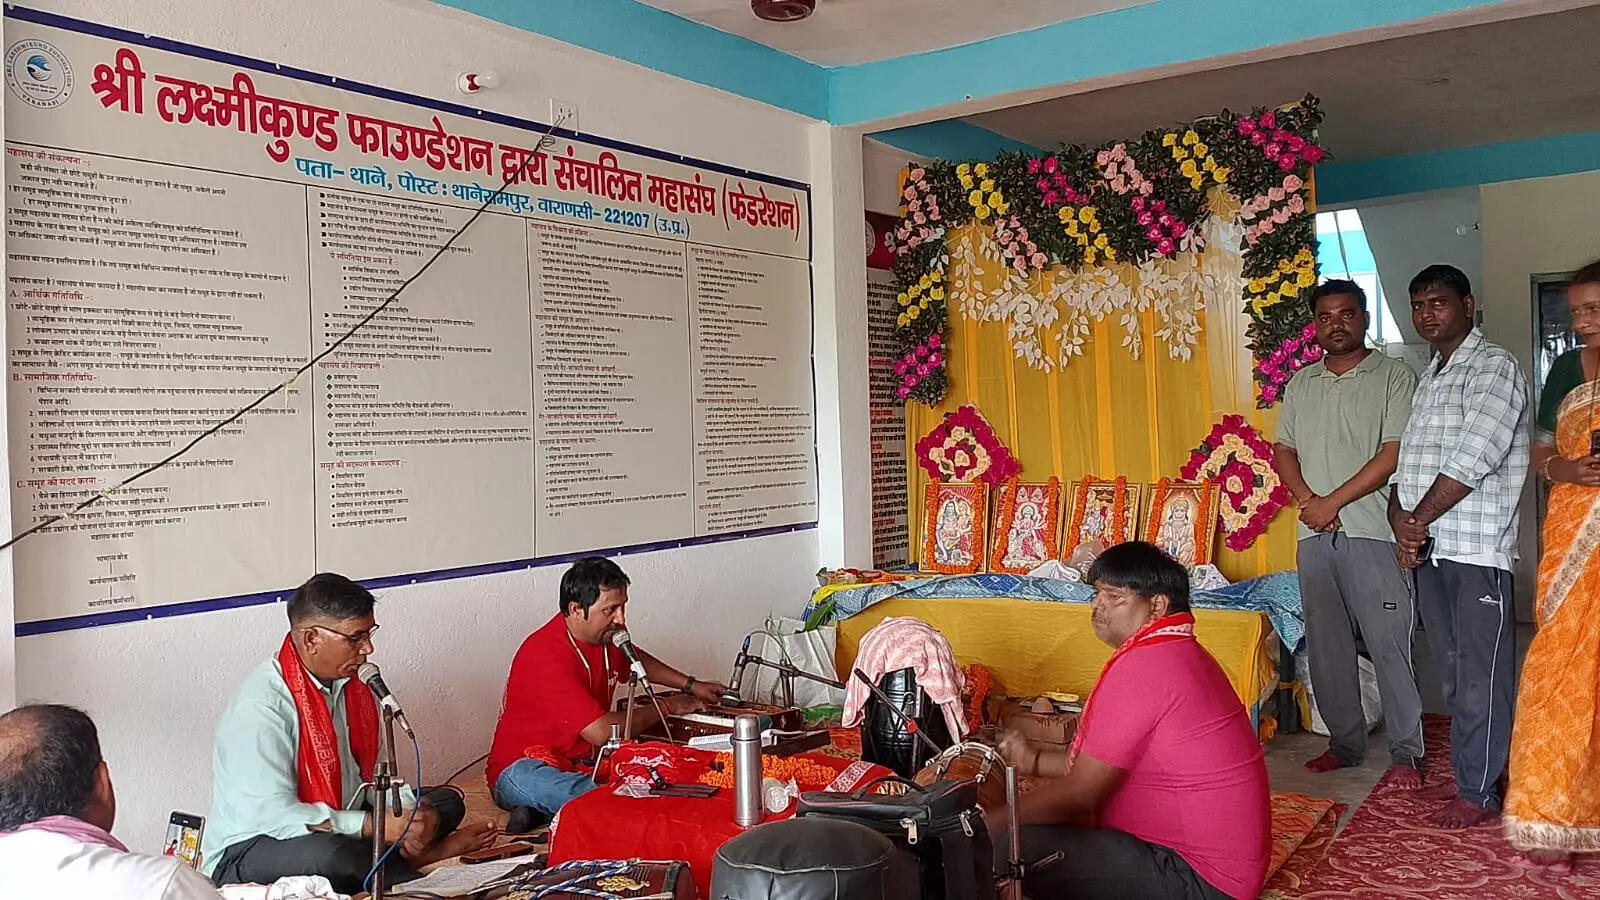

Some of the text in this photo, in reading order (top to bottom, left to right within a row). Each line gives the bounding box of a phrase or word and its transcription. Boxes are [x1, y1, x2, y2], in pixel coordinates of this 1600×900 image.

[22, 94, 59, 106] VARANASI
[90, 48, 146, 114] श्री
[154, 72, 340, 164] लक्ष्मीकुण्ड
[346, 112, 493, 176] फाउण्डेशन
[499, 144, 548, 187] द्वारा
[553, 144, 642, 204] संचालित
[646, 172, 717, 218] महासंघ
[721, 178, 801, 242] (फेडरेशन)
[349, 163, 393, 192] थाने,
[604, 208, 650, 230] 221207
[654, 213, 690, 240] (उ.प्र.)
